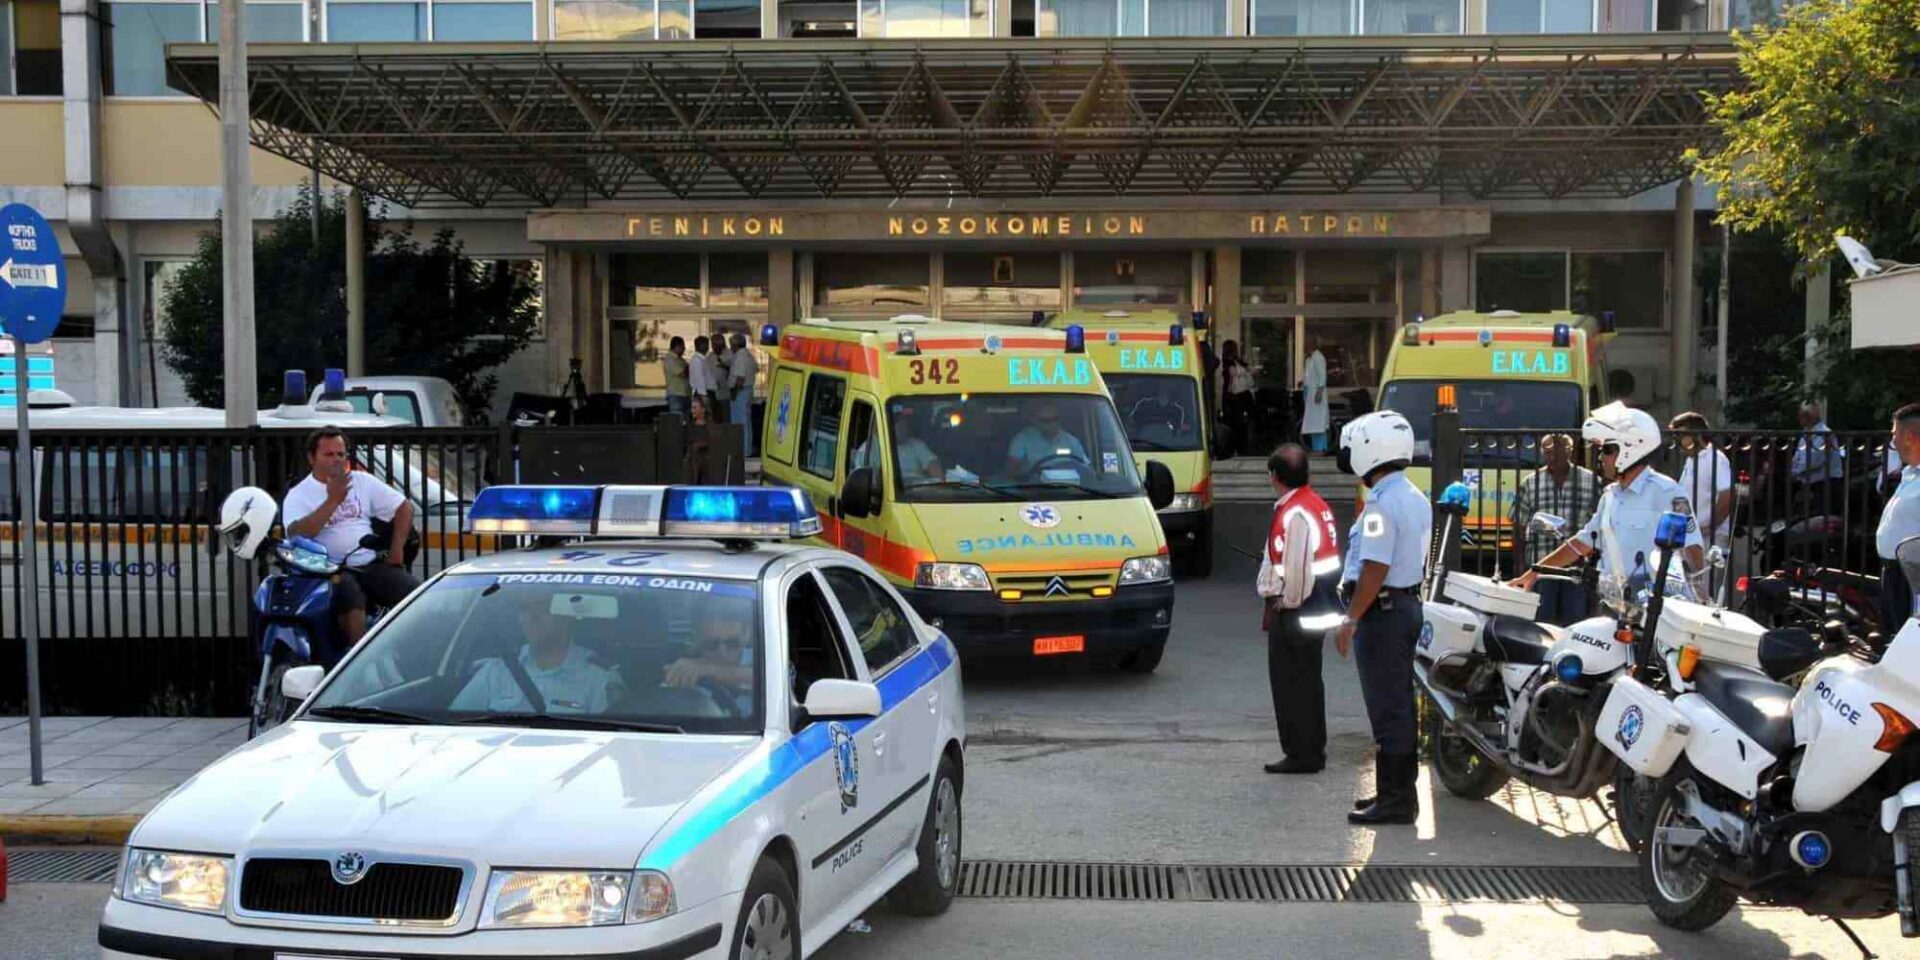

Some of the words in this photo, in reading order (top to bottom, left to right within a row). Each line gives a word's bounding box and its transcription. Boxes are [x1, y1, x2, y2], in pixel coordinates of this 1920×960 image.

[627, 217, 784, 236] ΓΕΝΙΚΟΝ
[889, 216, 1144, 235] ΝΟΣΟΚΟΜΕΙΟΝ
[1250, 215, 1389, 233] ΠΑΤΡΩΝ
[10, 268, 32, 280] GATE
[909, 358, 960, 385] 342
[497, 574, 584, 584] ΤΡΟΧΑΙΑ
[650, 578, 713, 592] ΟΔΩΝ
[1571, 632, 1612, 651] SUZUKI
[1814, 680, 1862, 725] POLICE
[832, 839, 863, 874] POLICE
